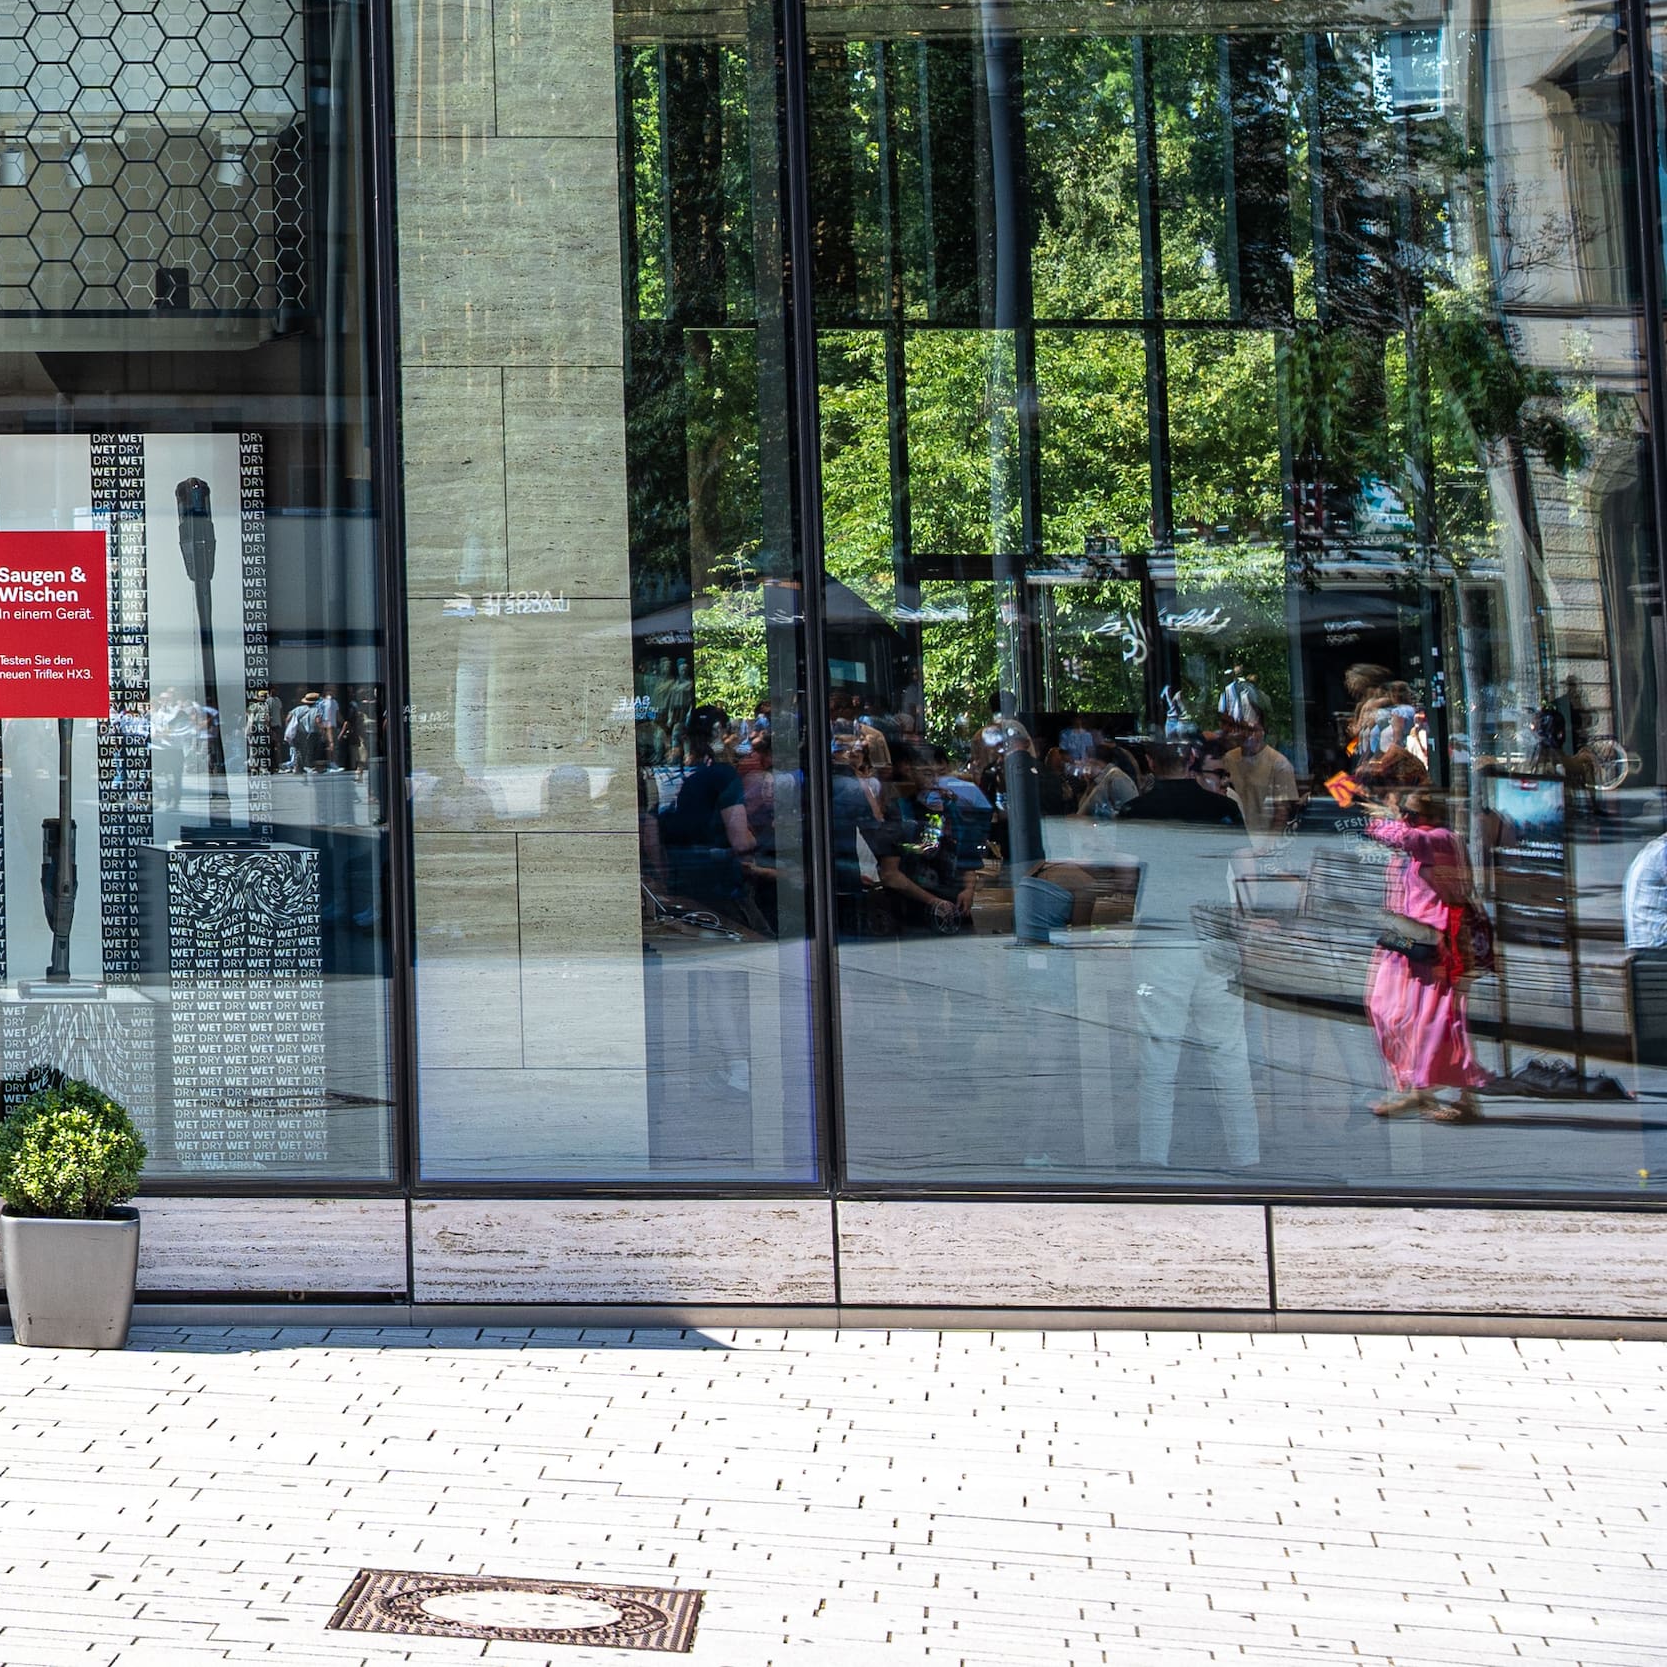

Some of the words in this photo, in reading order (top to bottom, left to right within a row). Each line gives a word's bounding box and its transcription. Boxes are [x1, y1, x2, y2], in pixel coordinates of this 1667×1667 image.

[93, 434, 115, 443] DRY
[118, 434, 143, 443] WET
[91, 445, 117, 454] WET
[119, 445, 140, 454] DRY
[93, 456, 115, 465] DRY
[119, 456, 144, 465] WET
[91, 467, 117, 476] WET
[119, 467, 141, 476] DRY
[94, 478, 116, 487] DRY
[119, 478, 145, 487] WET
[92, 490, 118, 498] WET
[120, 490, 142, 498] DRY
[95, 501, 117, 510] DRY
[120, 501, 146, 510] WET
[92, 512, 118, 521] WET
[121, 512, 142, 521] DRY
[70, 566, 87, 583] &
[13, 607, 53, 620] einem
[55, 607, 95, 620] Gerät.
[34, 654, 52, 666] Sie
[53, 654, 74, 666] den
[0, 671, 32, 680] neuen
[33, 668, 64, 680] Triflex
[66, 668, 95, 681] HX3.
[98, 736, 123, 745] WET
[126, 736, 147, 745] DRY
[98, 758, 124, 768] WET
[126, 758, 148, 768] DRY
[99, 803, 125, 812] WET
[128, 803, 149, 812] DRY
[100, 826, 125, 835] WET
[128, 826, 150, 835] DRY
[103, 837, 125, 846] DRY
[128, 837, 153, 846] WET
[171, 948, 195, 957] WET
[198, 948, 218, 957] DRY
[222, 948, 246, 957] WET
[250, 948, 270, 957] DRY
[274, 948, 298, 957] WET
[300, 948, 321, 957] DRY
[171, 959, 191, 968] DRY
[195, 959, 219, 968] WET
[223, 959, 243, 968] DRY
[247, 959, 271, 968] WET
[275, 959, 295, 968] DRY
[298, 959, 323, 968] WET
[171, 970, 195, 978] WET
[198, 970, 218, 978] DRY
[222, 970, 246, 978] WET
[250, 970, 270, 978] DRY
[273, 970, 297, 978] WET
[301, 970, 321, 978] DRY
[173, 980, 193, 989] DRY
[197, 980, 221, 989] WET
[224, 980, 245, 989] DRY
[248, 980, 272, 989] WET
[276, 980, 296, 989] DRY
[299, 980, 324, 989] WET
[171, 991, 195, 1000] WET
[198, 991, 219, 1000] DRY
[222, 991, 246, 1000] WET
[250, 991, 270, 1000] DRY
[274, 991, 298, 1000] WET
[301, 991, 322, 1000] DRY
[173, 1002, 193, 1010] DRY
[197, 1002, 221, 1010] WET
[225, 1002, 245, 1010] DRY
[249, 1002, 273, 1010] WET
[277, 1002, 297, 1010] DRY
[300, 1002, 325, 1010] WET
[172, 1012, 196, 1021] WET
[199, 1012, 219, 1021] DRY
[223, 1012, 247, 1021] WET
[251, 1012, 271, 1021] DRY
[274, 1012, 299, 1021] WET
[302, 1012, 322, 1021] DRY
